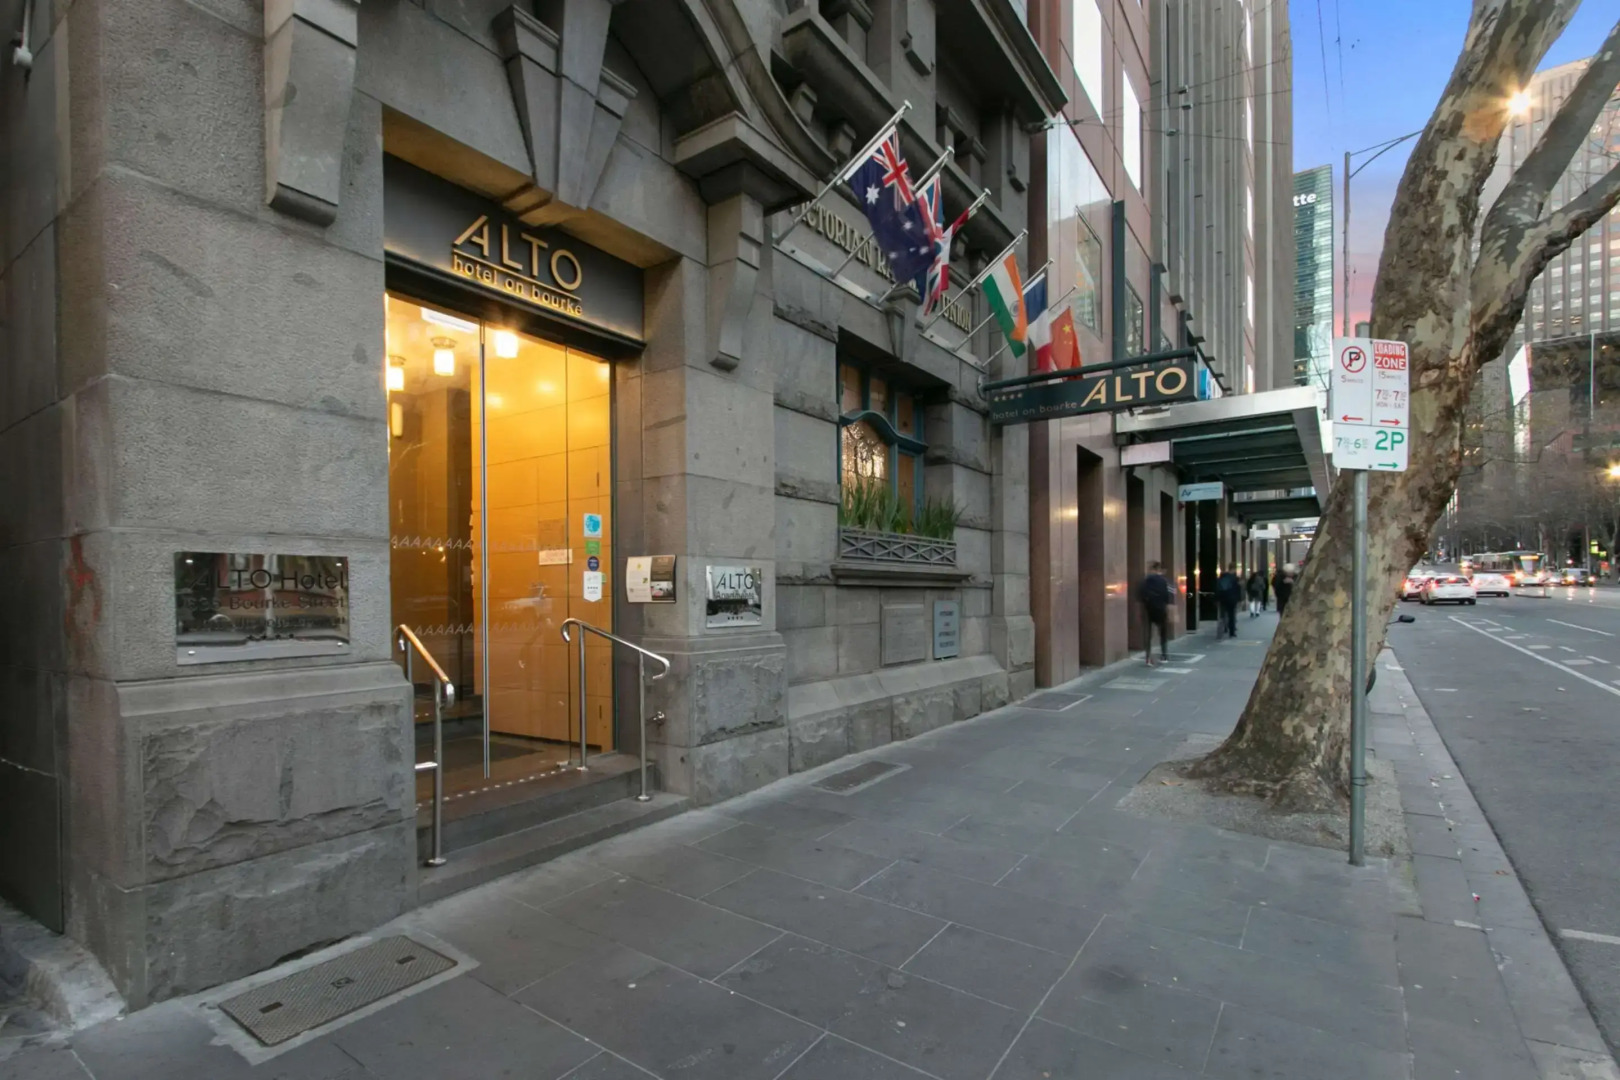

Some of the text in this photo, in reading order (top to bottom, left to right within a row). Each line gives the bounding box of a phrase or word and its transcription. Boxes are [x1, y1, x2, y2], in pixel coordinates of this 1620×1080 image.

[452, 214, 583, 291] ALTO
[453, 254, 583, 317] hotel on bourke
[941, 292, 972, 335] UNION
[1374, 342, 1405, 357] LOADING
[1375, 356, 1407, 369] ZONE
[1081, 367, 1187, 408] ALTO
[992, 401, 1078, 420] hotel on bourke
[1375, 430, 1405, 451] 2P
[190, 569, 344, 590] ALTO Hotel
[716, 573, 754, 590] ALTO
[230, 597, 291, 610] Bourke
[299, 596, 345, 609] Street
